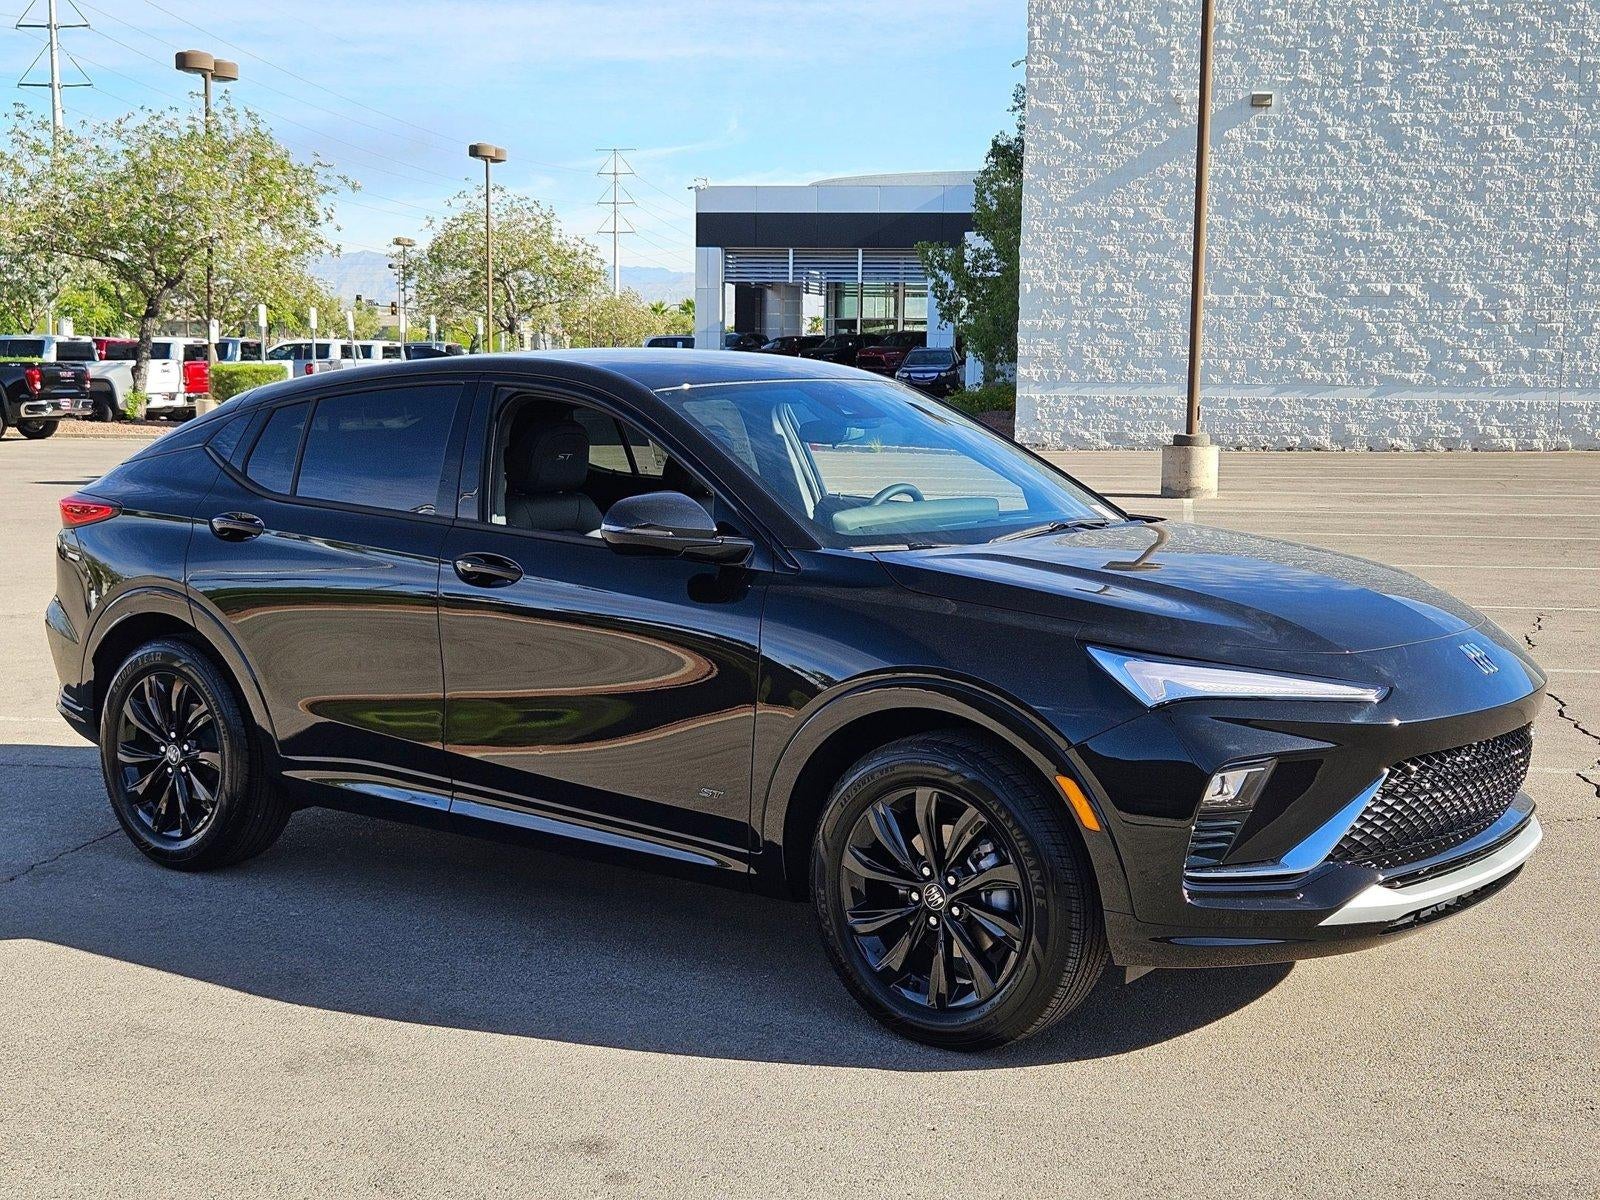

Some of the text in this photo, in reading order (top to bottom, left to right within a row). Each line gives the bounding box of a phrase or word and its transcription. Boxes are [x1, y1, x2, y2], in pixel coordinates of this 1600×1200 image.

[556, 453, 574, 461] ST
[699, 788, 725, 799] ST
[987, 799, 1048, 909] ASSURANCE
